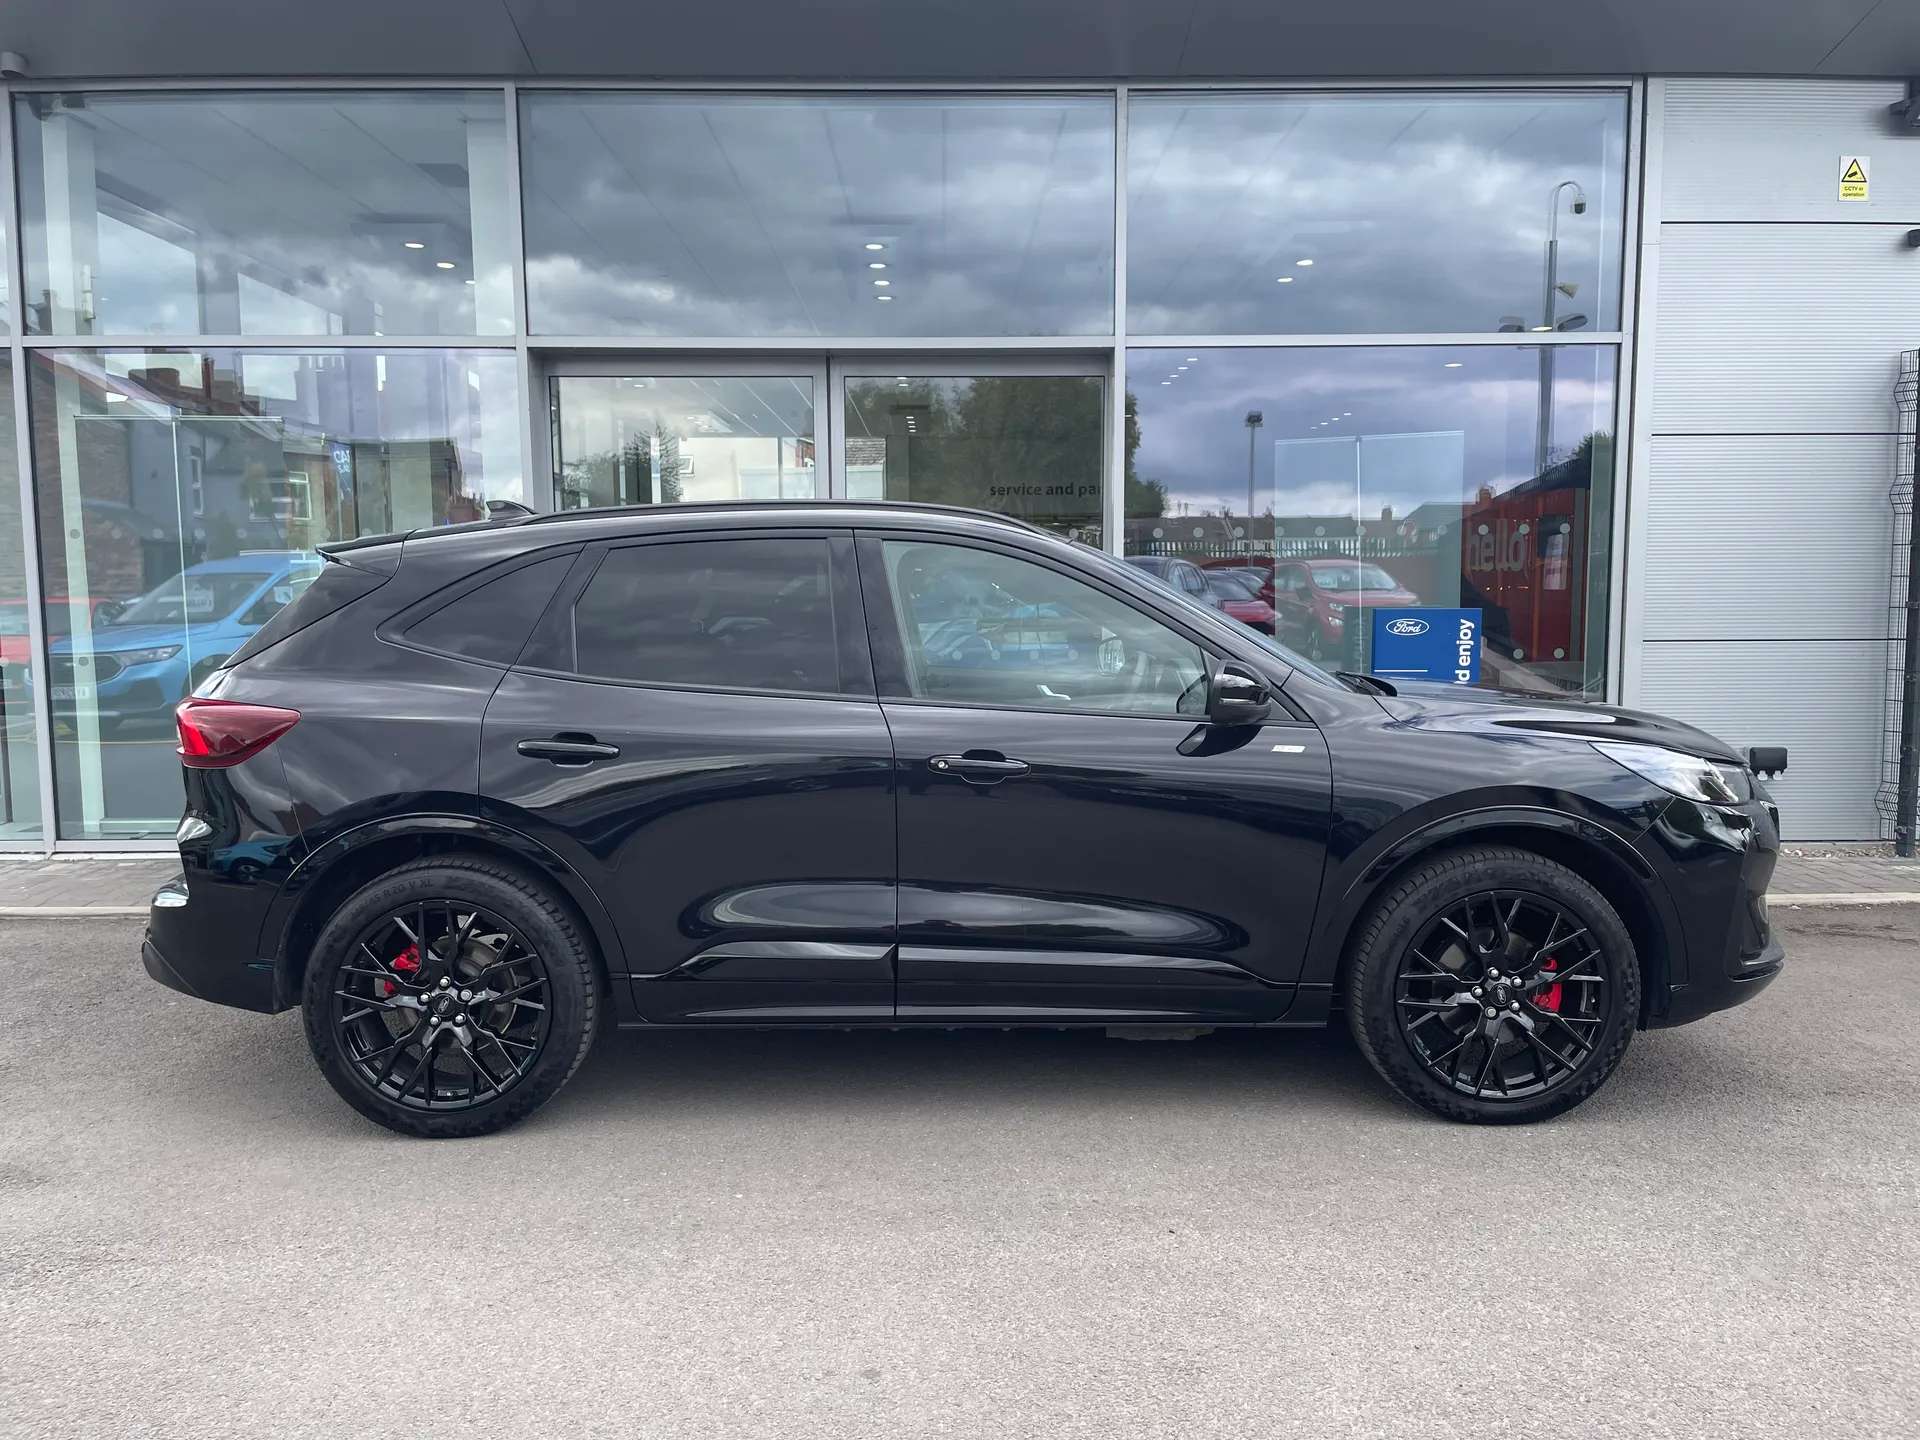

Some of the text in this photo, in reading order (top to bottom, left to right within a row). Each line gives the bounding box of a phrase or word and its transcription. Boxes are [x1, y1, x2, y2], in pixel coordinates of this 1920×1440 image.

[990, 484, 1042, 496] service
[1046, 483, 1074, 496] and
[1393, 621, 1422, 633] Ford
[1456, 619, 1475, 667] enjoy
